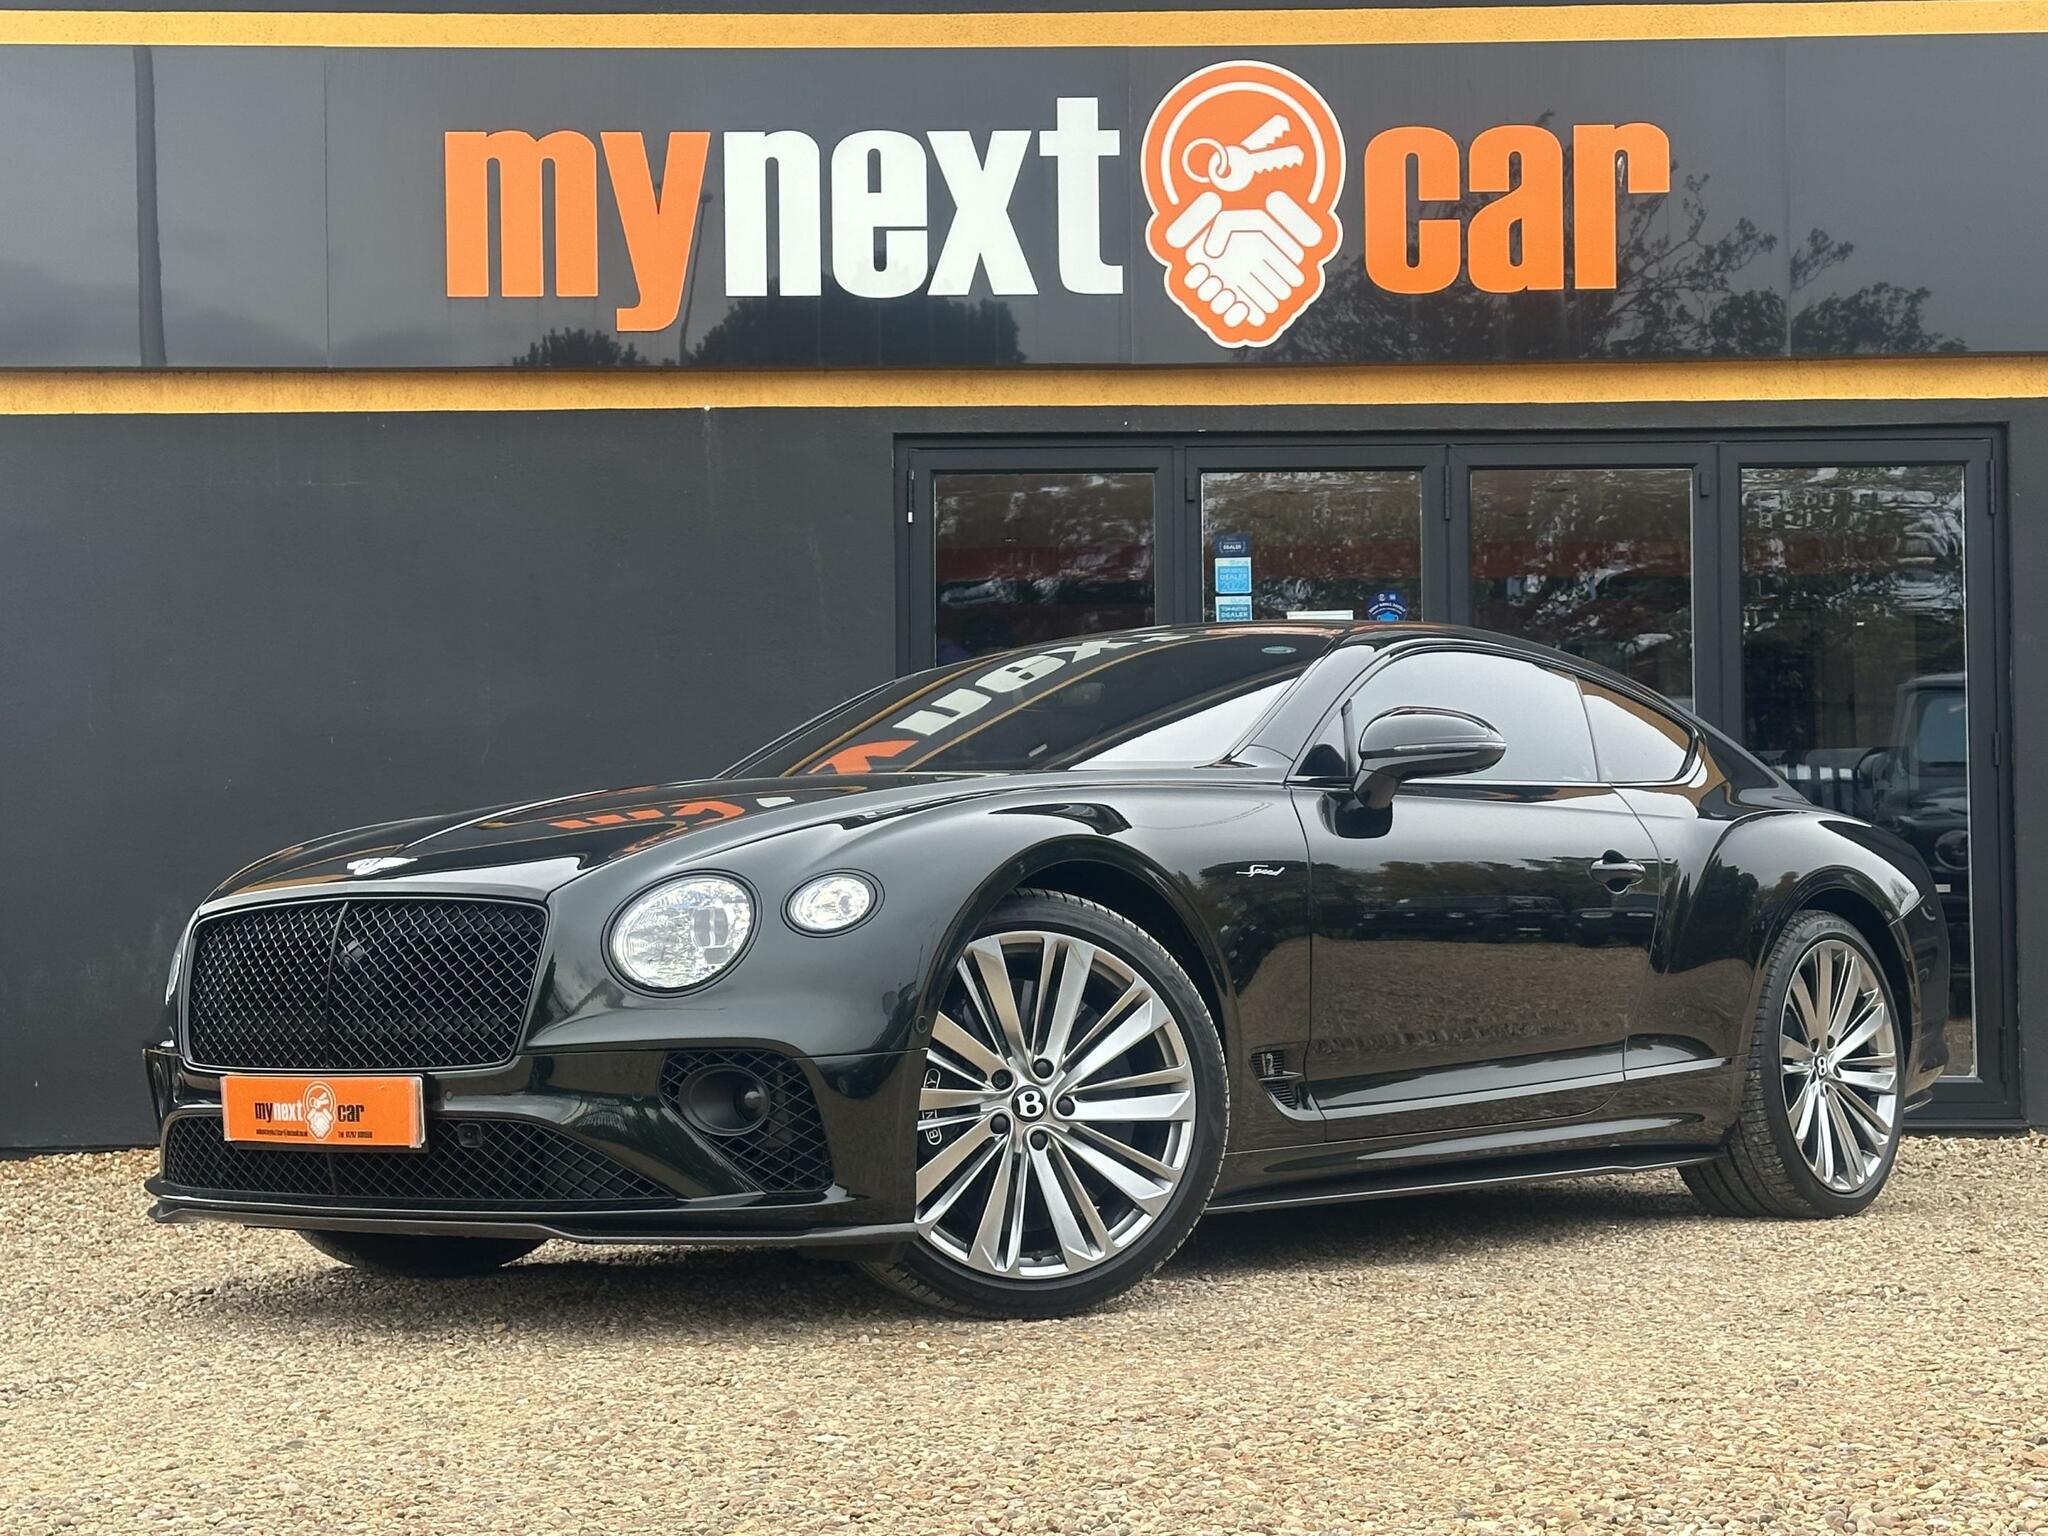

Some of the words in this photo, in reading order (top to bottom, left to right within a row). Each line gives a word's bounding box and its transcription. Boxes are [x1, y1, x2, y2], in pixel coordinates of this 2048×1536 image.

[1363, 121, 1671, 295] car
[337, 1104, 364, 1122] car
[1017, 1090, 1044, 1117] B
